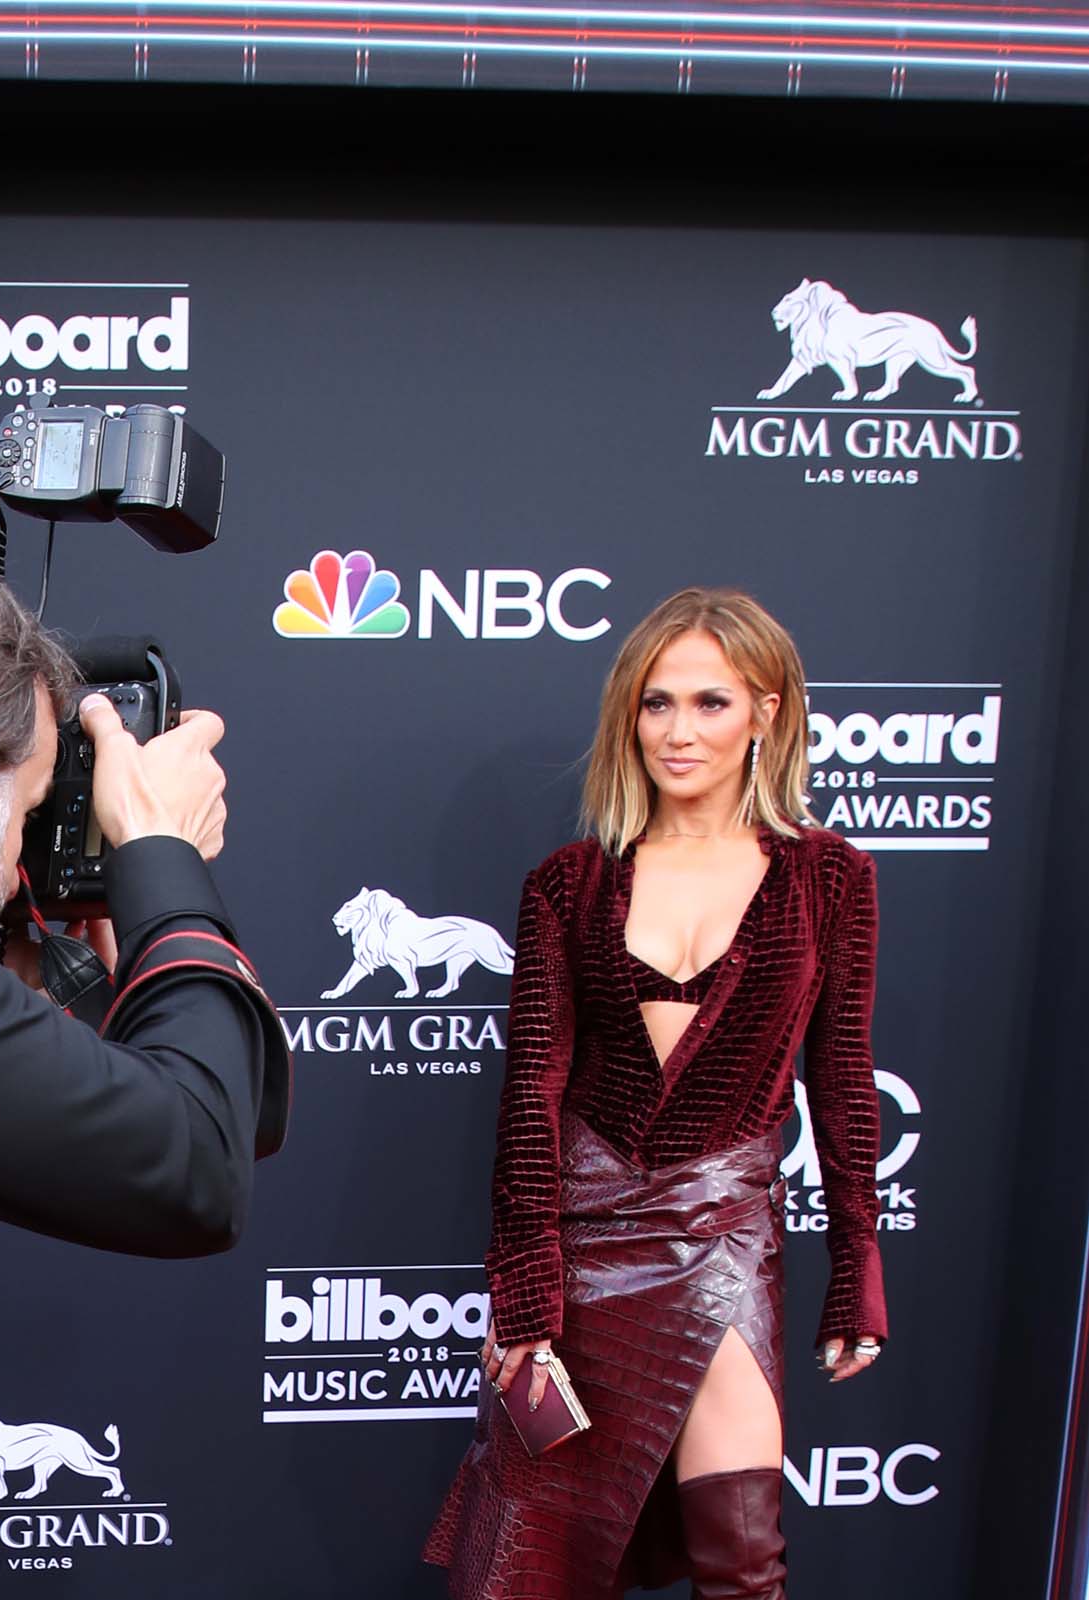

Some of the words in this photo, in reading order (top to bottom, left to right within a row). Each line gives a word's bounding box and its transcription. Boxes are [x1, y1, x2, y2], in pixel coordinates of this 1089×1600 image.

[704, 416, 832, 458] MGM
[844, 418, 1021, 460] GRAND
[804, 468, 845, 484] LAS
[851, 469, 919, 485] VEGAS
[417, 567, 612, 642] NBC
[812, 770, 876, 788] 2018
[823, 794, 992, 831] AWARDS
[280, 1015, 395, 1052] MGM
[370, 1062, 409, 1075] LAS
[415, 1061, 481, 1075] VEGAS
[387, 1346, 450, 1362] 2018
[263, 1369, 387, 1402] MUSIC
[783, 1443, 942, 1507] NBC
[0, 1511, 165, 1548] GRAND
[7, 1557, 73, 1570] VEGAS
